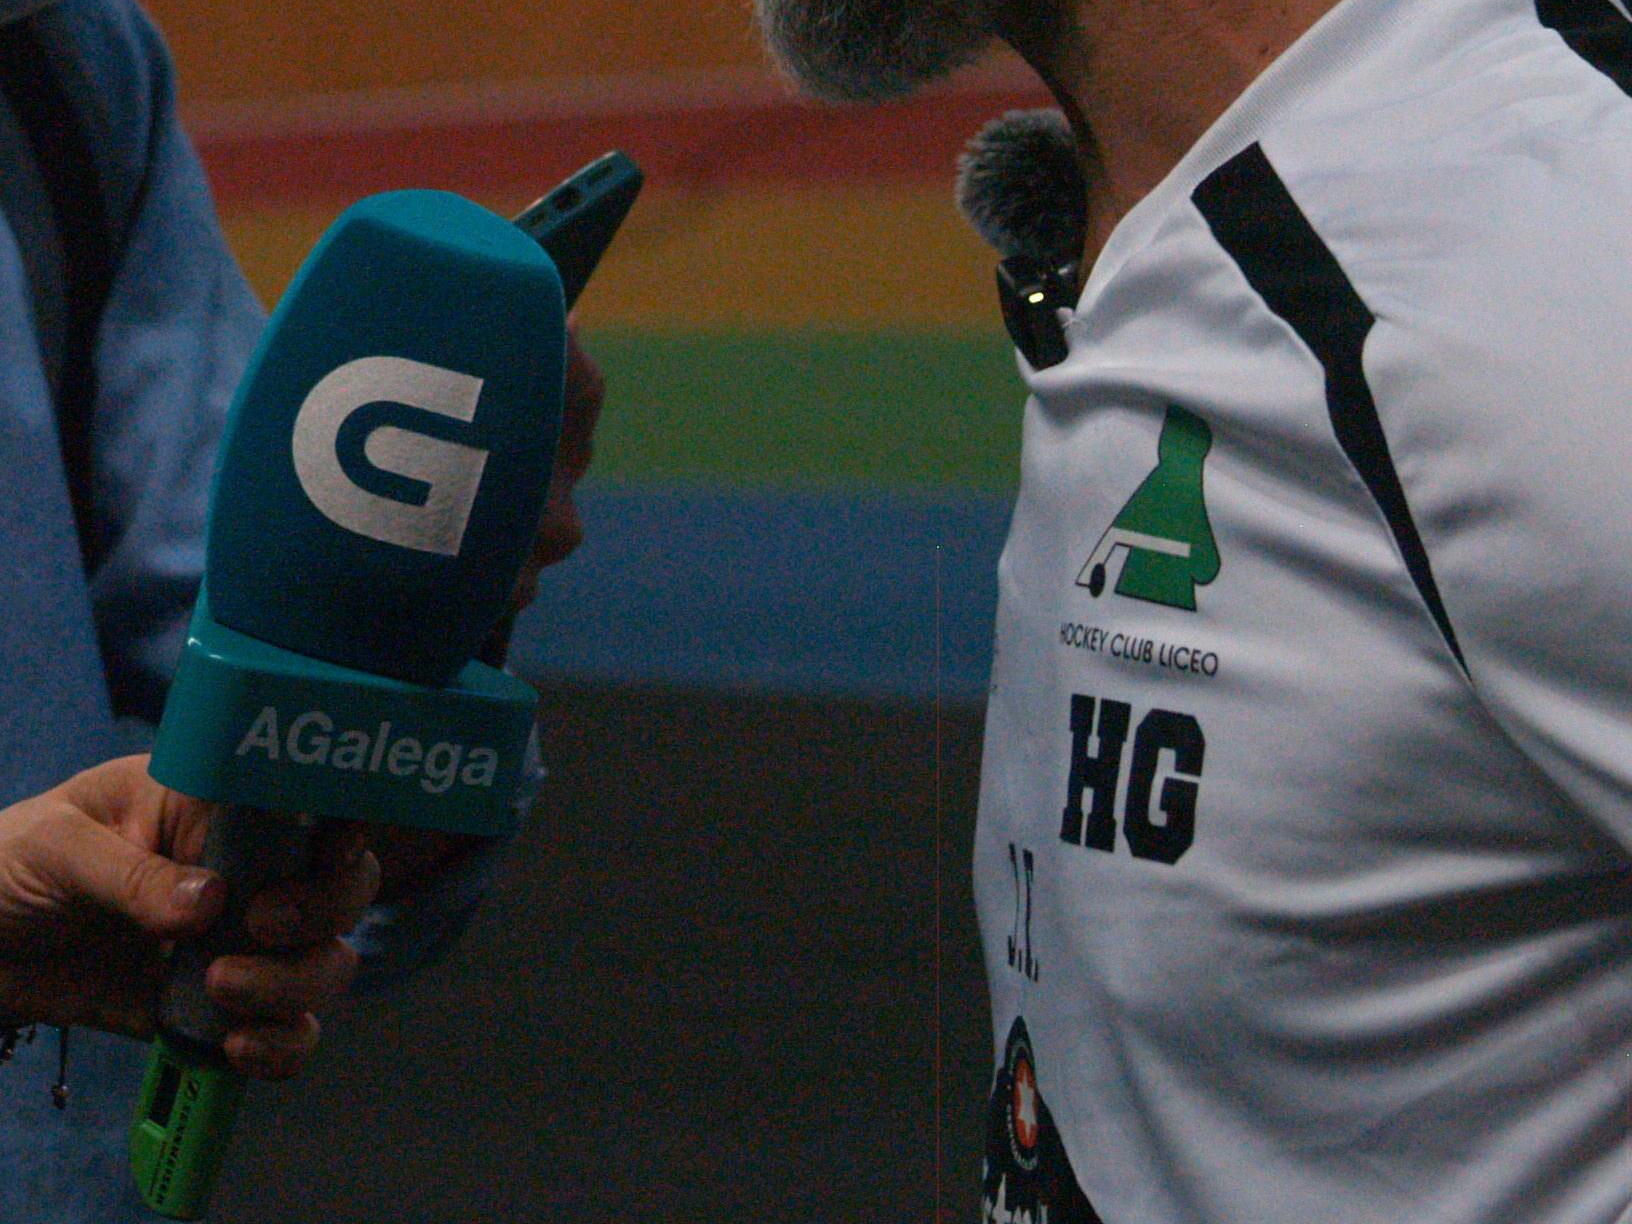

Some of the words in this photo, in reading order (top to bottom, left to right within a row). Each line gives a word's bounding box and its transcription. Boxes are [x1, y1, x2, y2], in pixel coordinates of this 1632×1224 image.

[292, 355, 490, 557] G
[1060, 622, 1109, 652] HOCKEY
[1110, 633, 1154, 664] CLUB
[1159, 643, 1219, 676] LICEO
[234, 705, 498, 793] AGalega
[1060, 693, 1205, 866] HG
